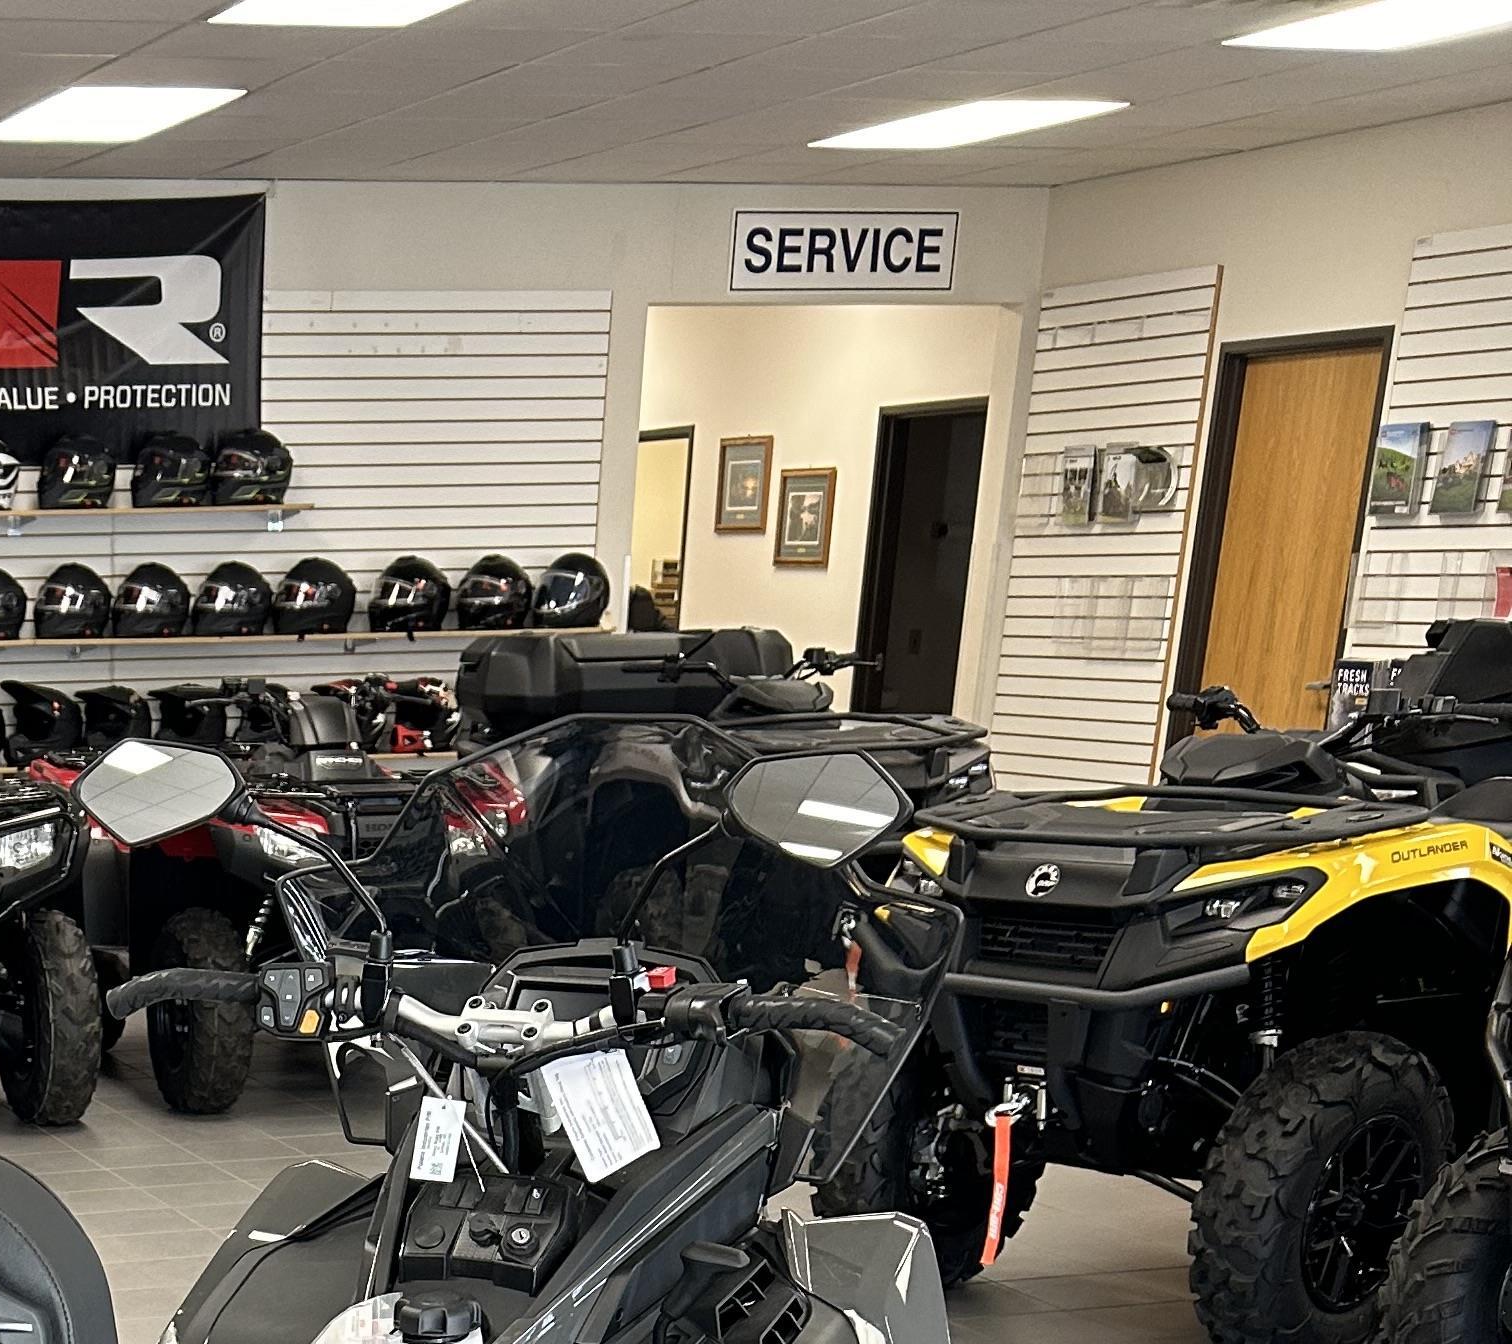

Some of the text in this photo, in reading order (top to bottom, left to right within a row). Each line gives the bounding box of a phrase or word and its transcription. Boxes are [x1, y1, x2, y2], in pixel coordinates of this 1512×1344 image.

[744, 227, 944, 274] SERVICE
[84, 383, 230, 409] PROTECTION
[1337, 668, 1368, 682] FRESH
[1337, 682, 1370, 696] TRACKS
[1391, 840, 1469, 863] OUTLANDER
